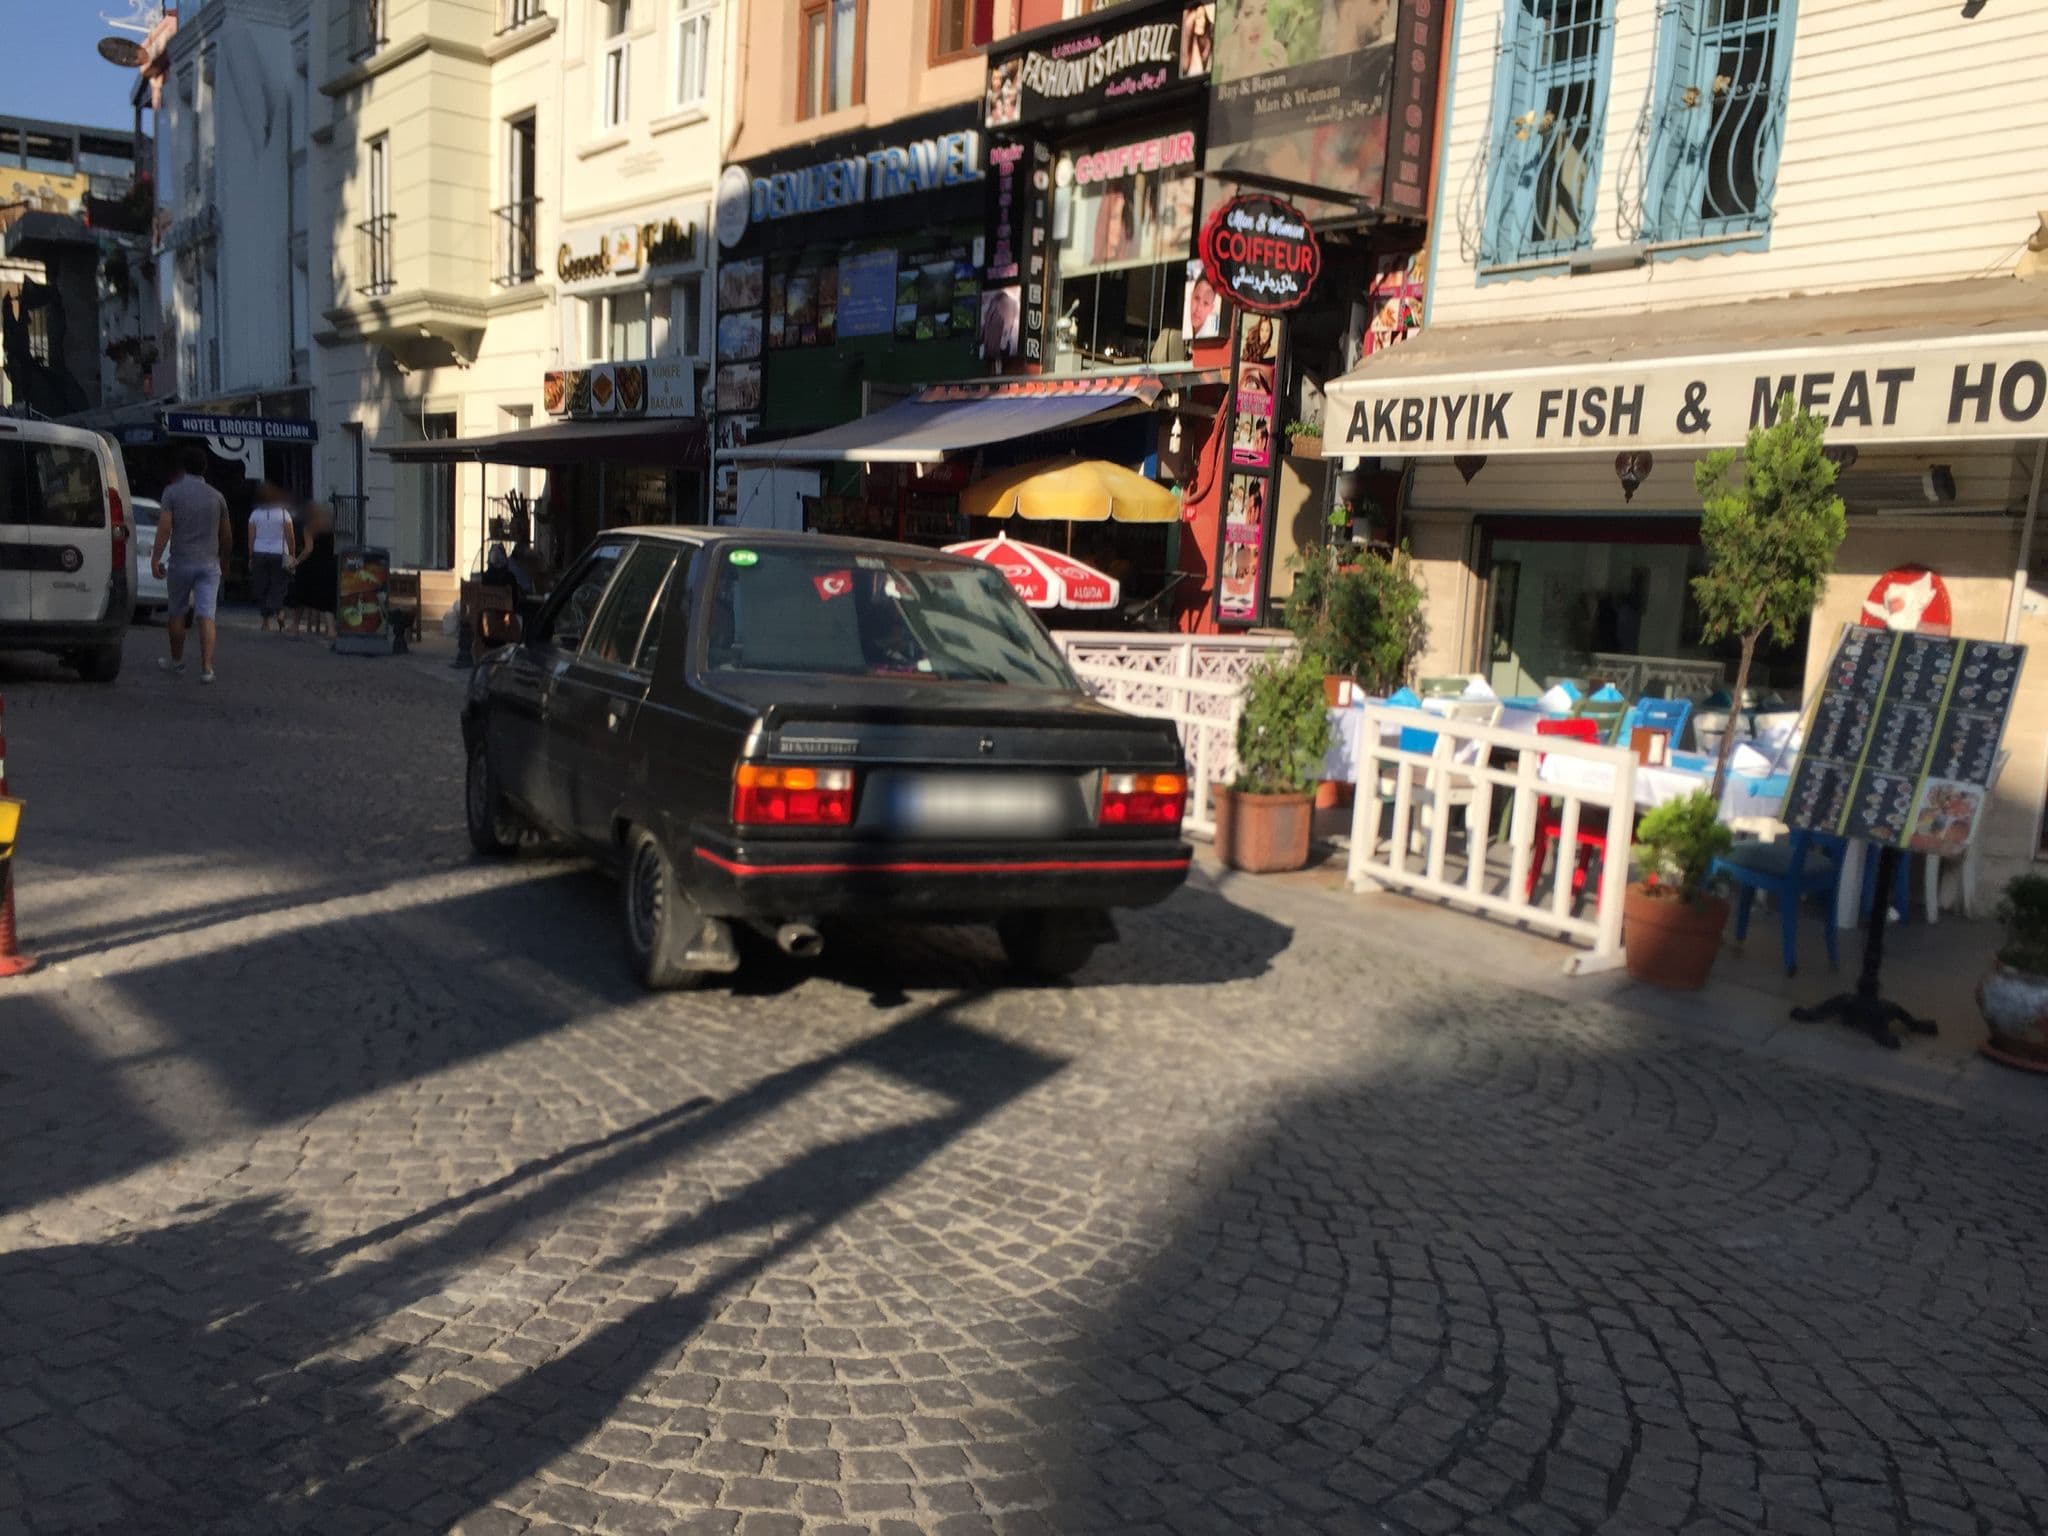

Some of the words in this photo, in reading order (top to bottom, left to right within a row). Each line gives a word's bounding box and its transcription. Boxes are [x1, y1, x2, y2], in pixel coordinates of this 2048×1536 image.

[1021, 50, 1089, 98] FASHION
[1255, 97, 1281, 115] Man
[1294, 84, 1341, 105] Woman
[867, 129, 986, 201] TRAVEL
[1074, 130, 1195, 186] COIFFEUR
[1215, 229, 1313, 275] COIFFEUR
[1346, 391, 1514, 443] AKBIYIK
[1536, 384, 1645, 439] FISH
[1676, 380, 1711, 435] &
[1749, 366, 1916, 431] MEAT
[1947, 360, 2047, 424] HO
[182, 417, 218, 433] HOTEL
[219, 418, 262, 435] BROKEN
[264, 421, 310, 438] COLUMN
